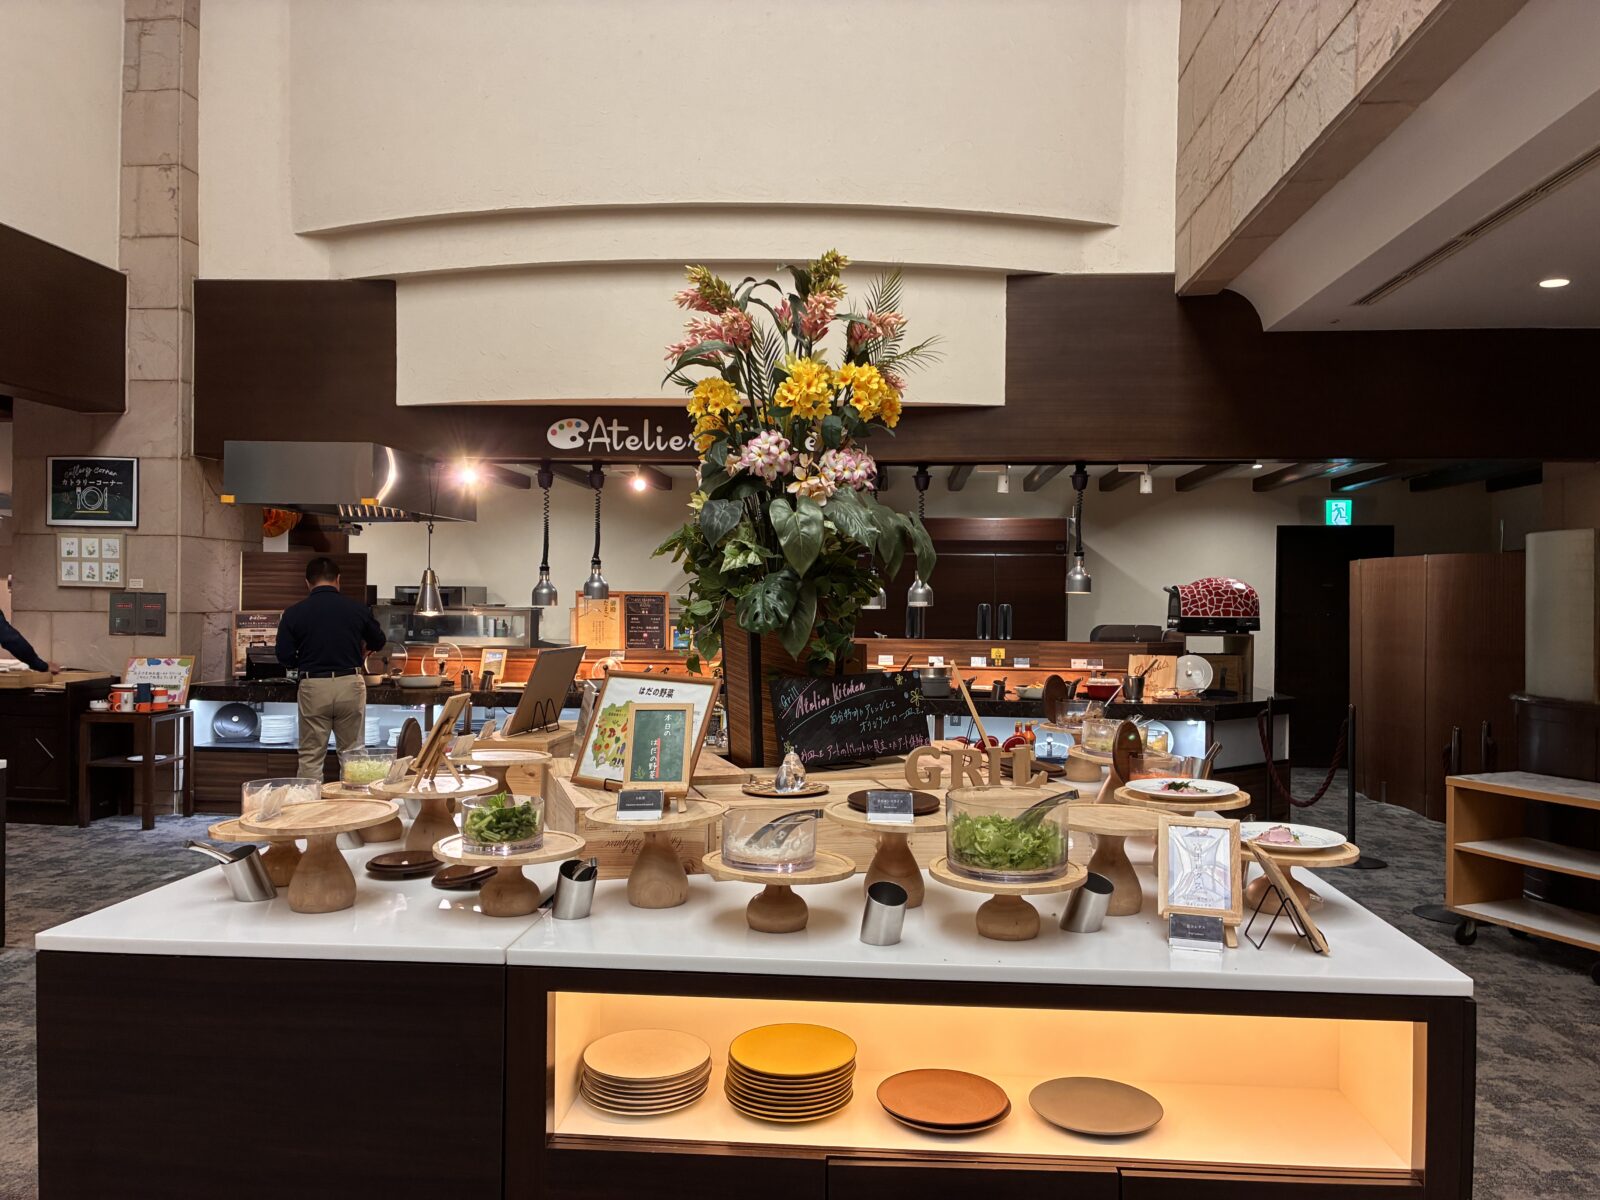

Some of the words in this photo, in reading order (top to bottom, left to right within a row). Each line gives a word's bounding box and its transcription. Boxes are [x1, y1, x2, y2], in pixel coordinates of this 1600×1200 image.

[62, 479, 123, 487] カトラリーコーナー
[638, 686, 675, 699] はだの野菜
[781, 686, 800, 708] Grill
[795, 690, 830, 719] Atelier
[831, 679, 867, 704] Kitchen
[663, 714, 672, 736] 本日の
[649, 740, 658, 780] はだの野菜
